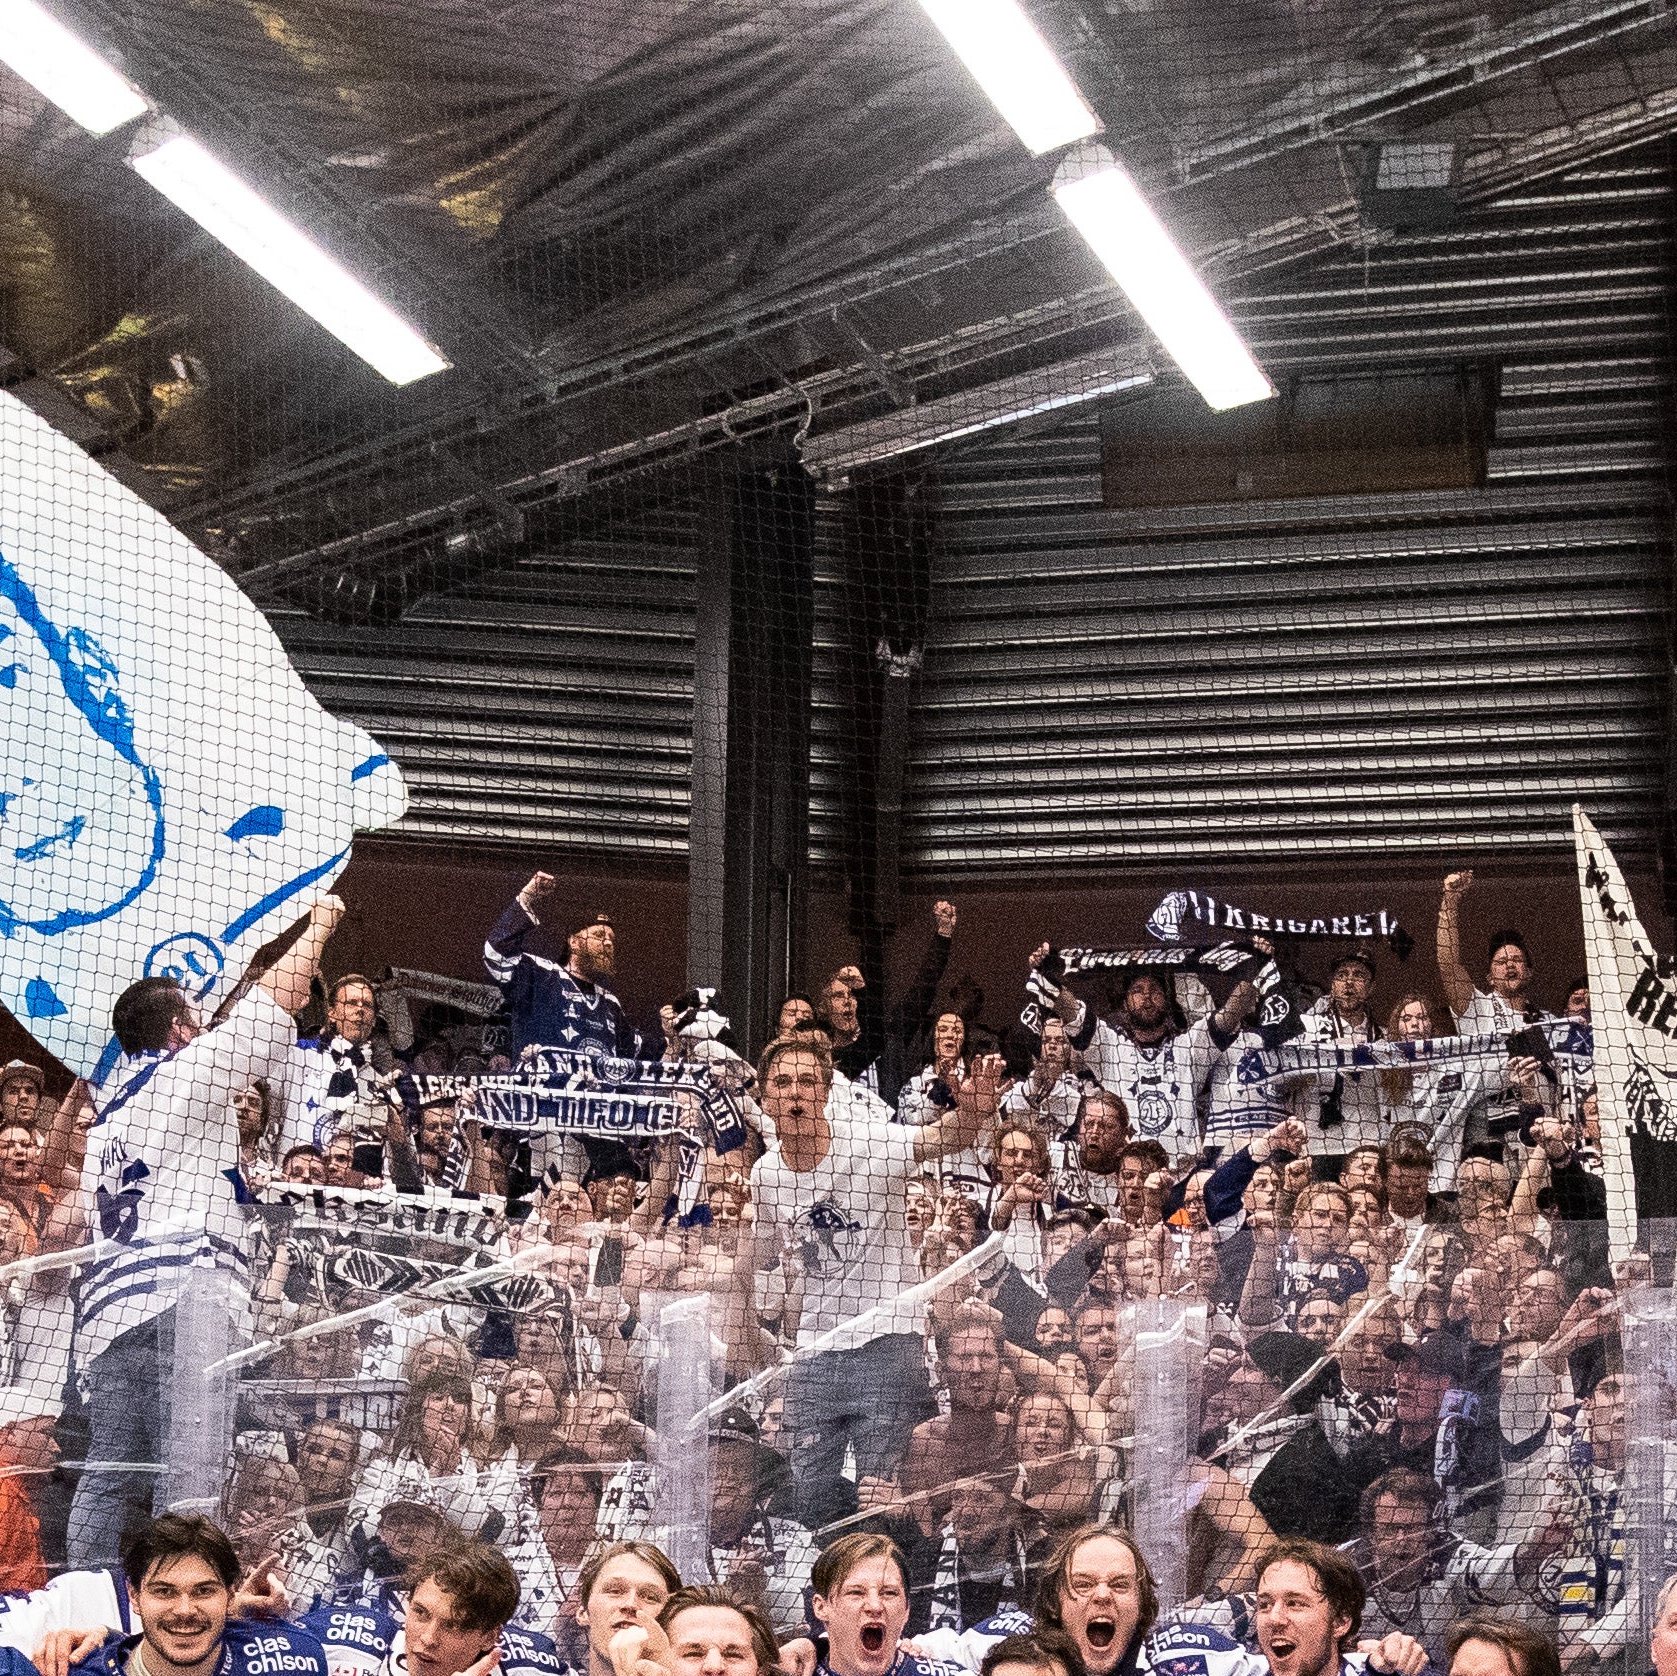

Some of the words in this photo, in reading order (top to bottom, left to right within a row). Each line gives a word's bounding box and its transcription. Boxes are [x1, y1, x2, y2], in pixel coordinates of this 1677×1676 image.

[556, 1097, 637, 1132] TIFO
[330, 1613, 377, 1631] clas
[244, 1635, 291, 1657] clas
[248, 1654, 319, 1674] ohlson
